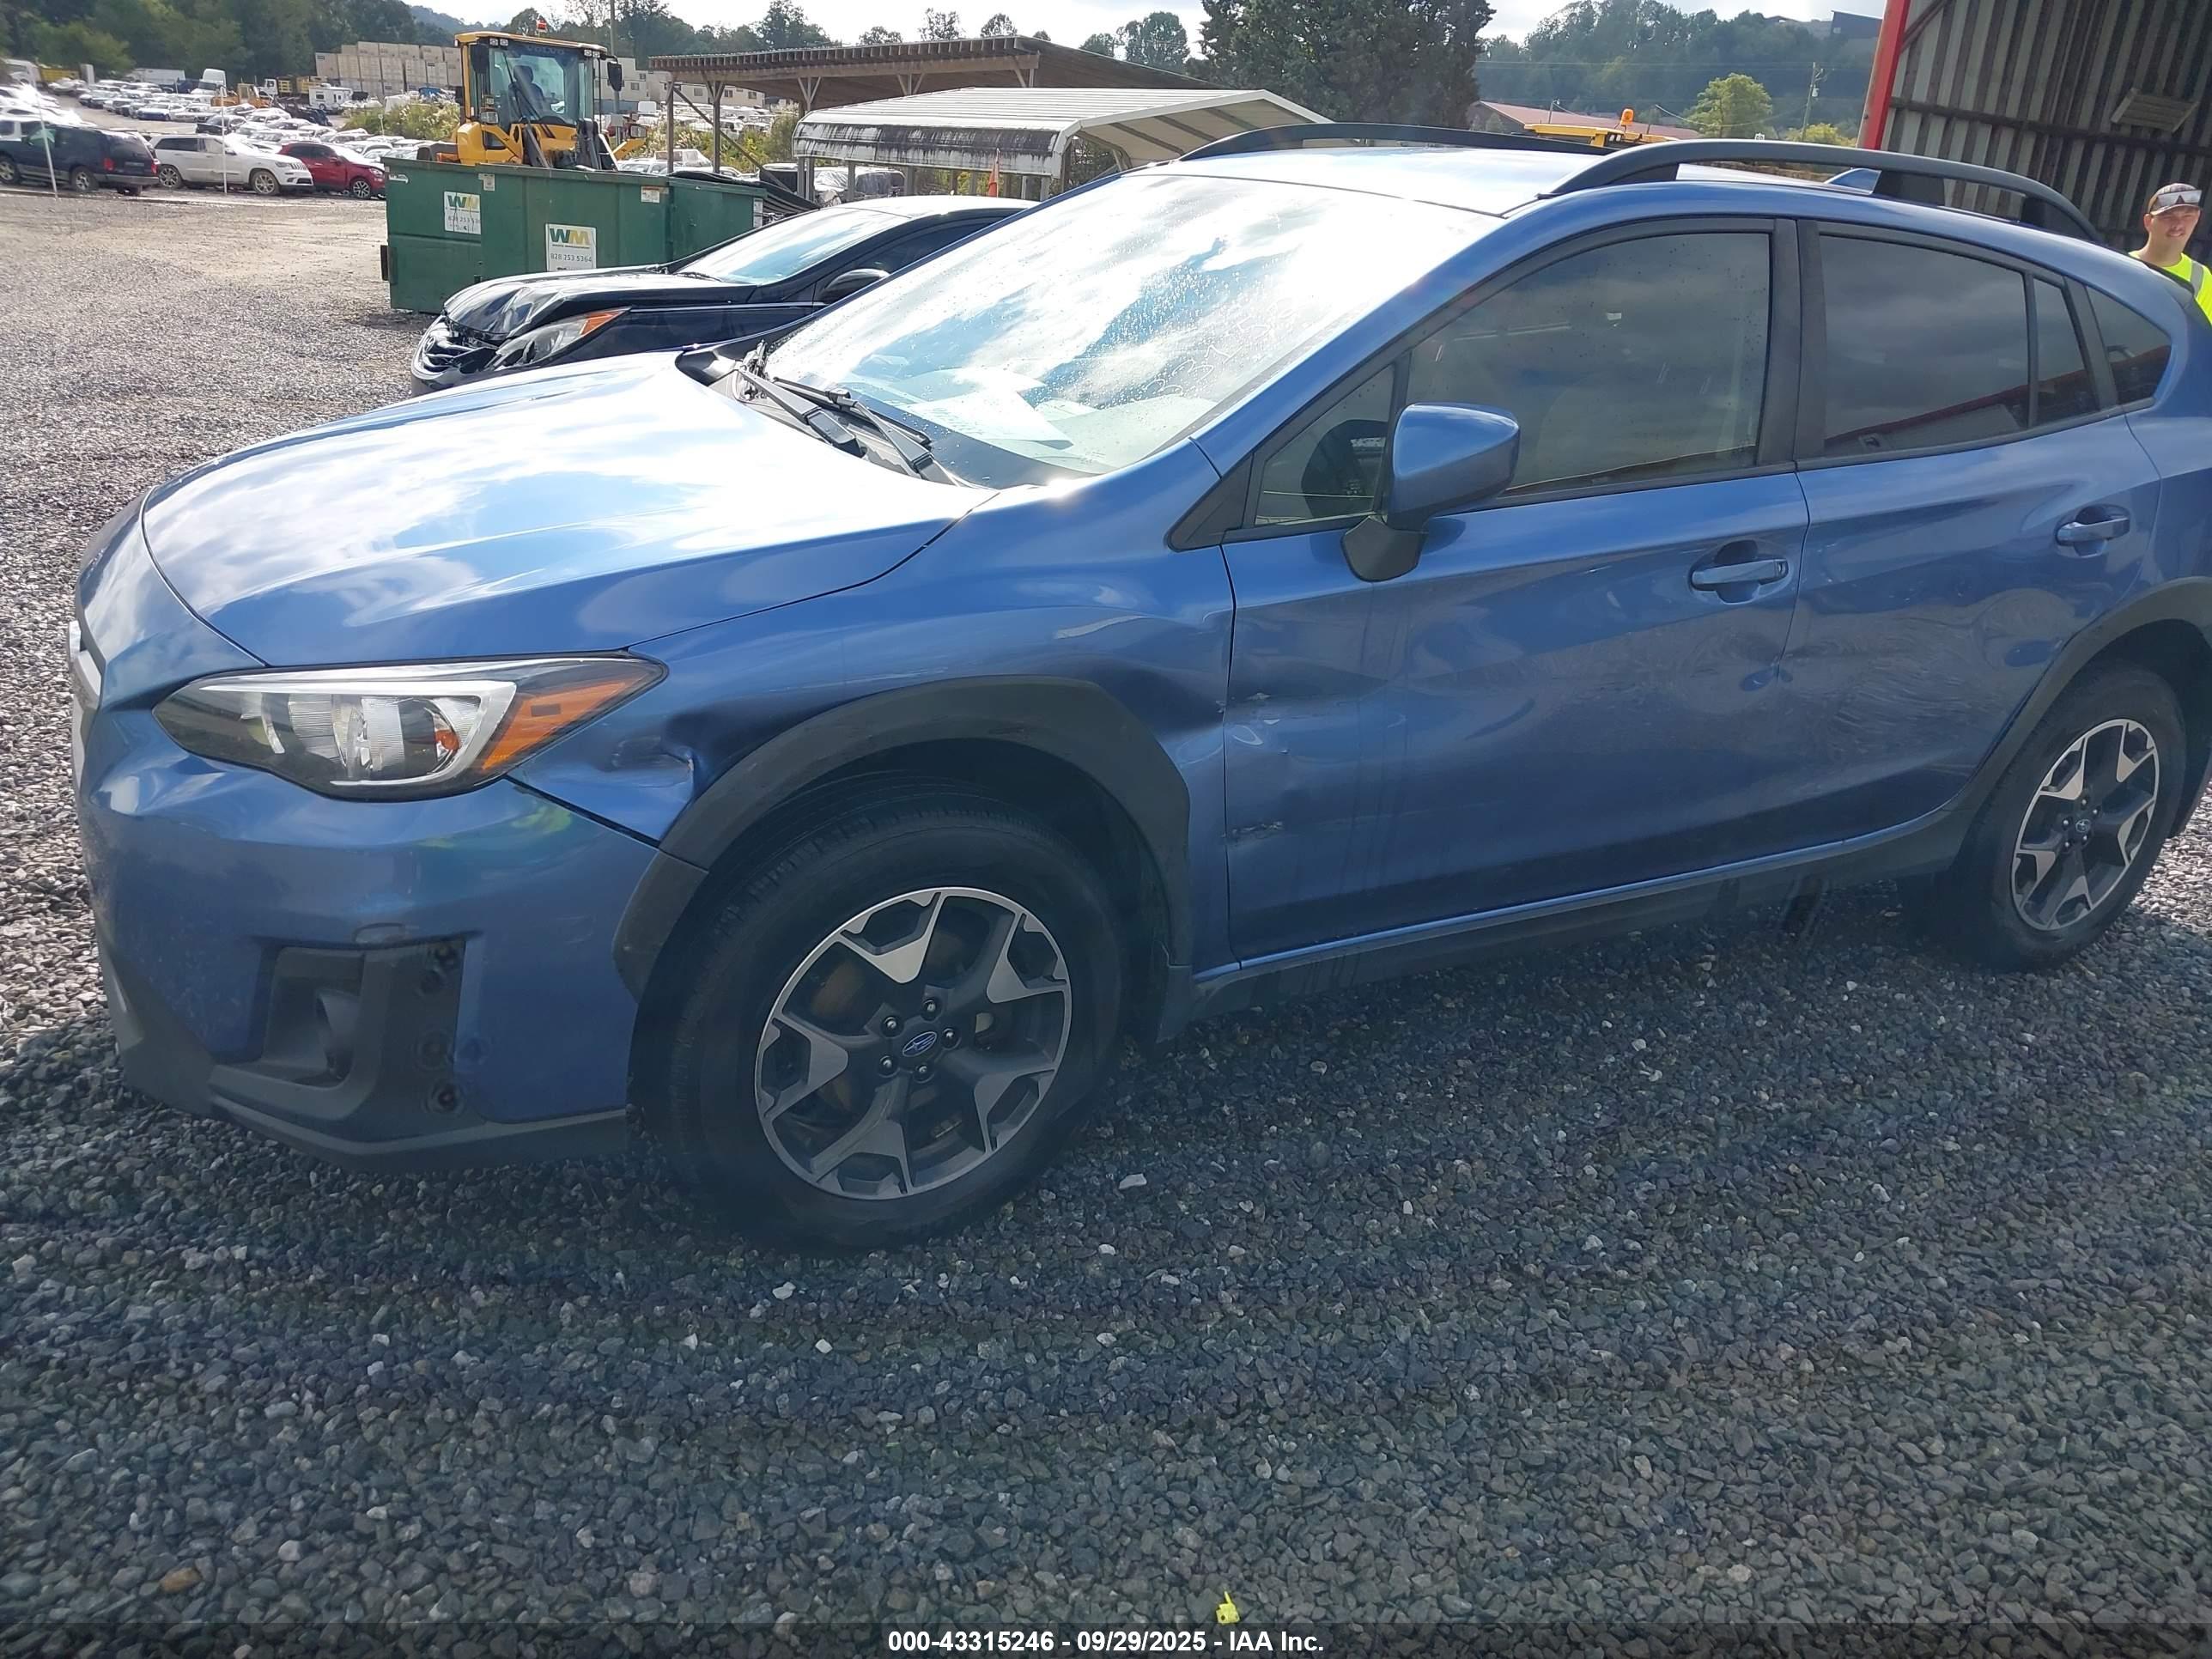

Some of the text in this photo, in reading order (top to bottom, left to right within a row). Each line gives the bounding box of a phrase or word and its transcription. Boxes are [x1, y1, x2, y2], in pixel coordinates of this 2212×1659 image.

[526, 45, 565, 56] VOLVO
[447, 195, 479, 210] WM
[550, 228, 590, 246] WM
